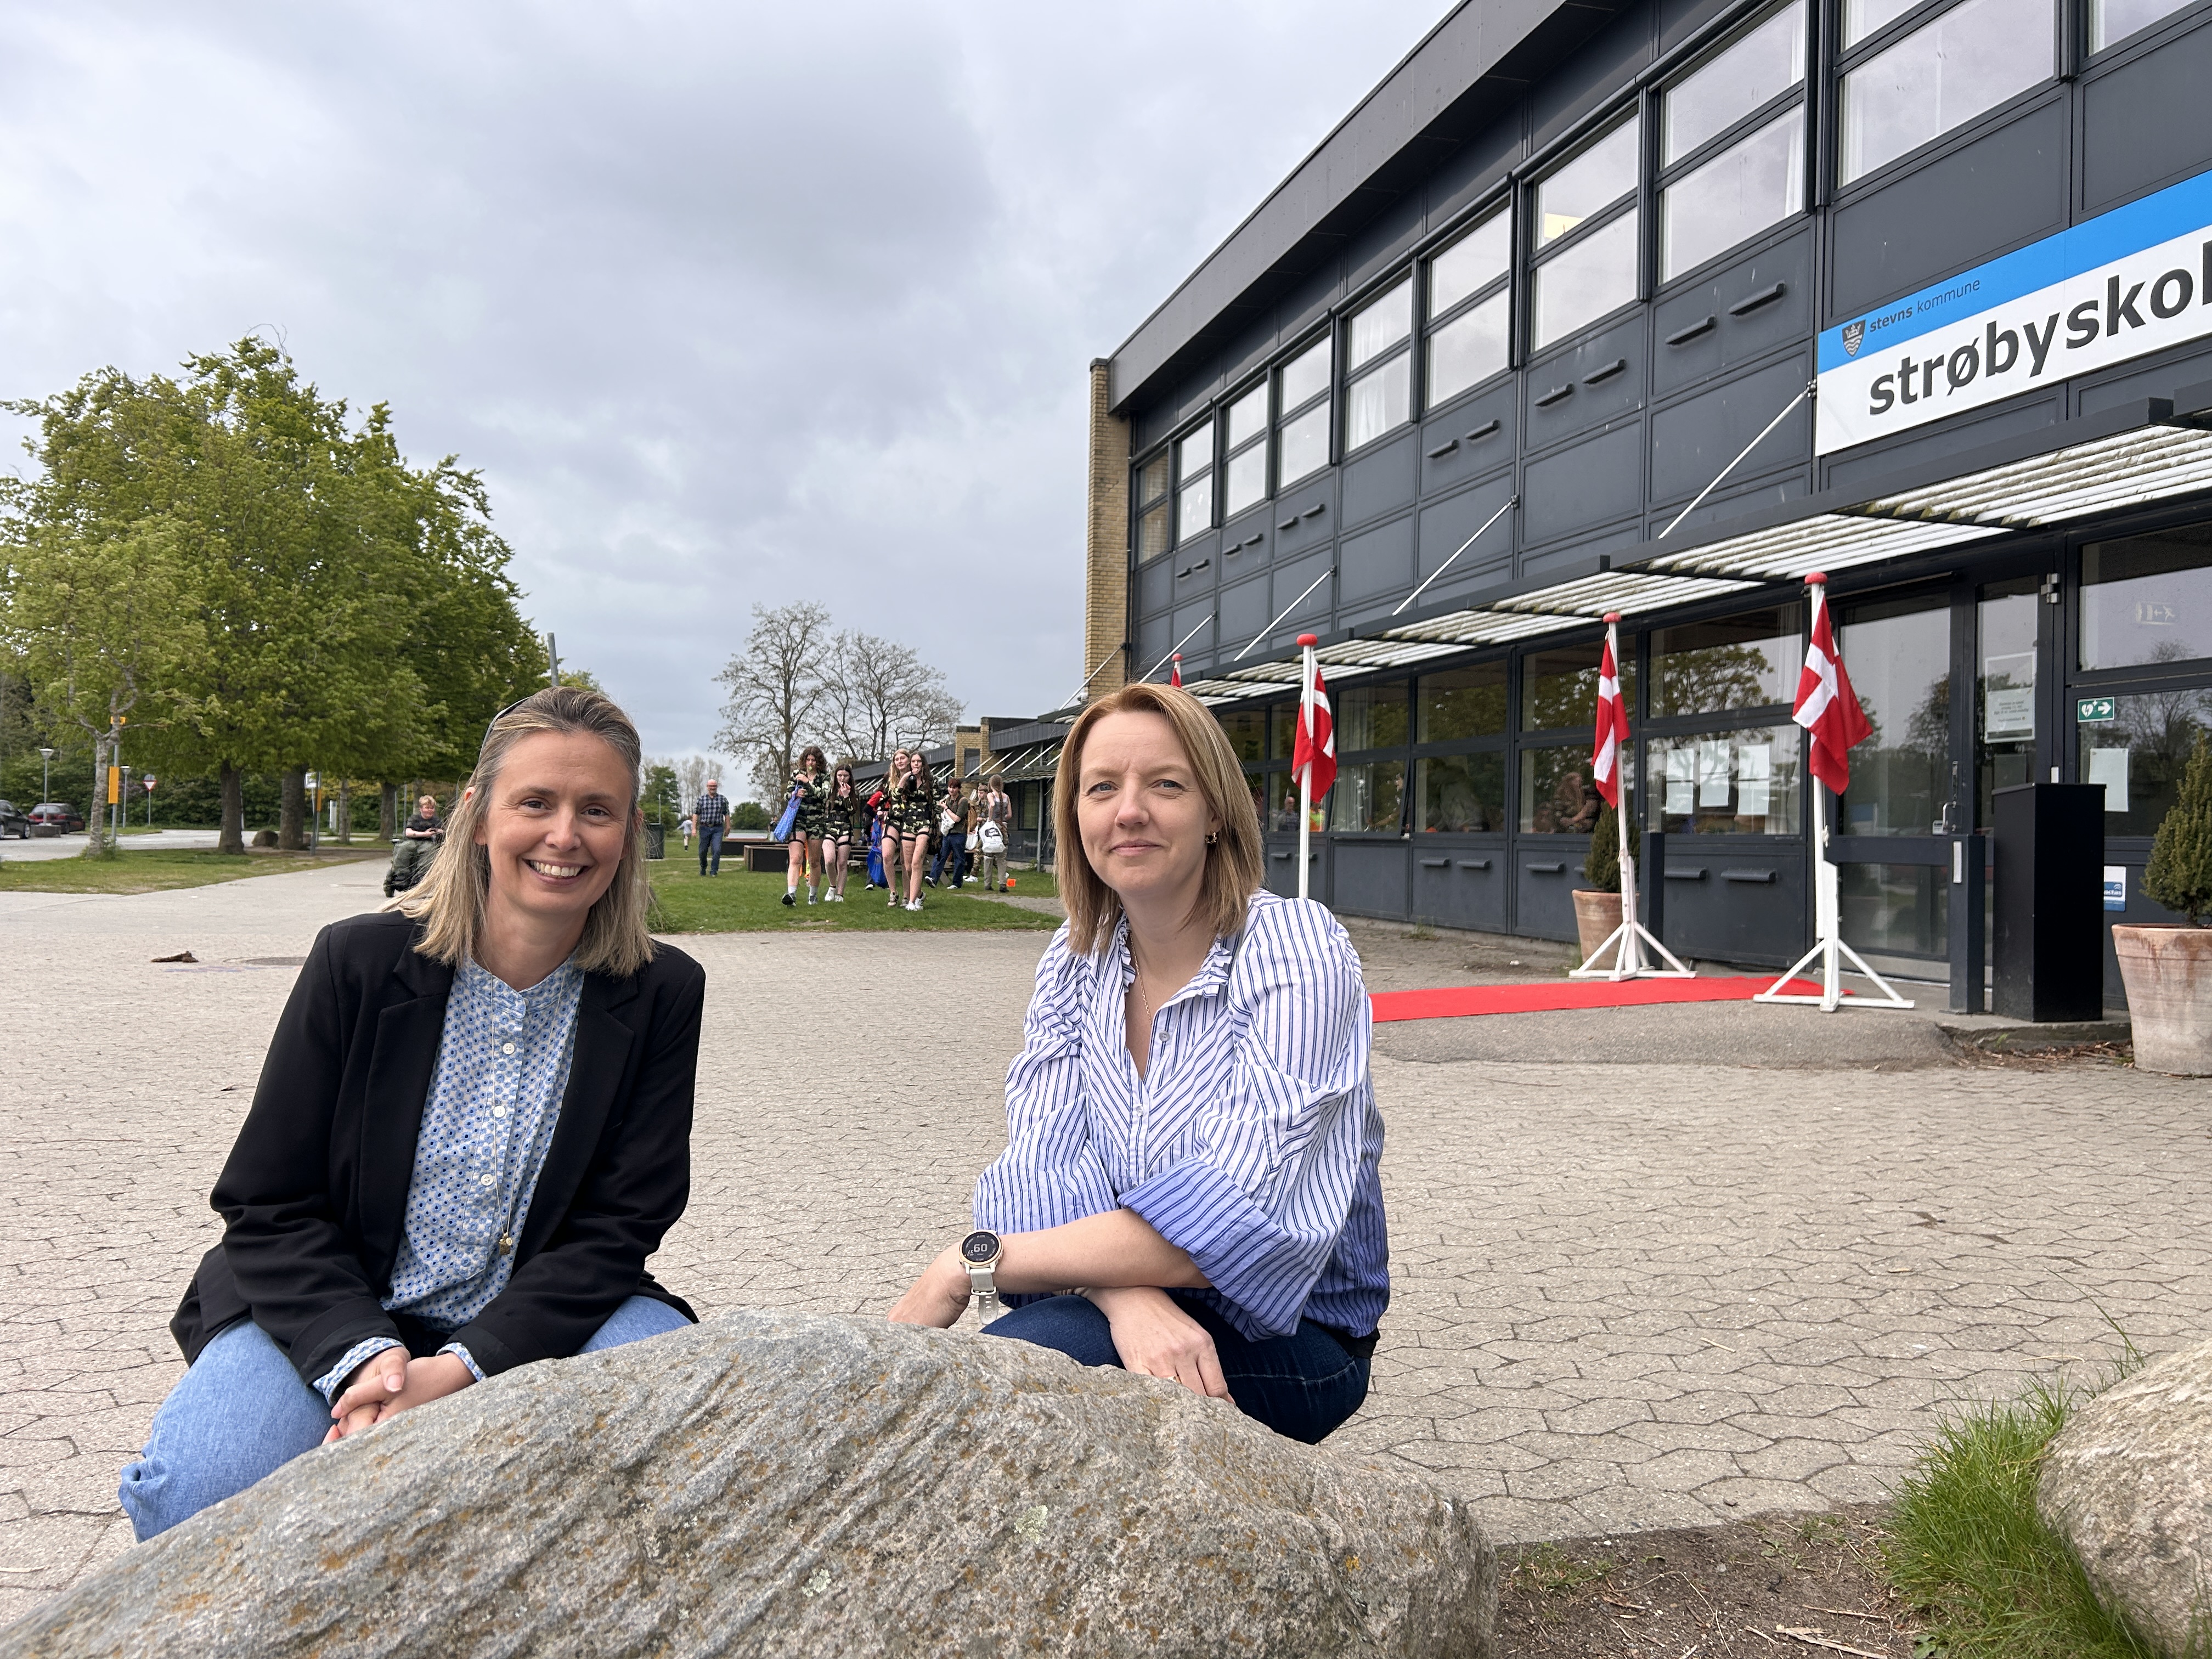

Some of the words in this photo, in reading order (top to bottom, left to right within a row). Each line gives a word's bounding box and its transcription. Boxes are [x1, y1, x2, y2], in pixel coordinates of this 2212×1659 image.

[1869, 239, 2212, 416] strøbyskol
[1870, 306, 1913, 333] stevns
[1917, 279, 1980, 314] kommune
